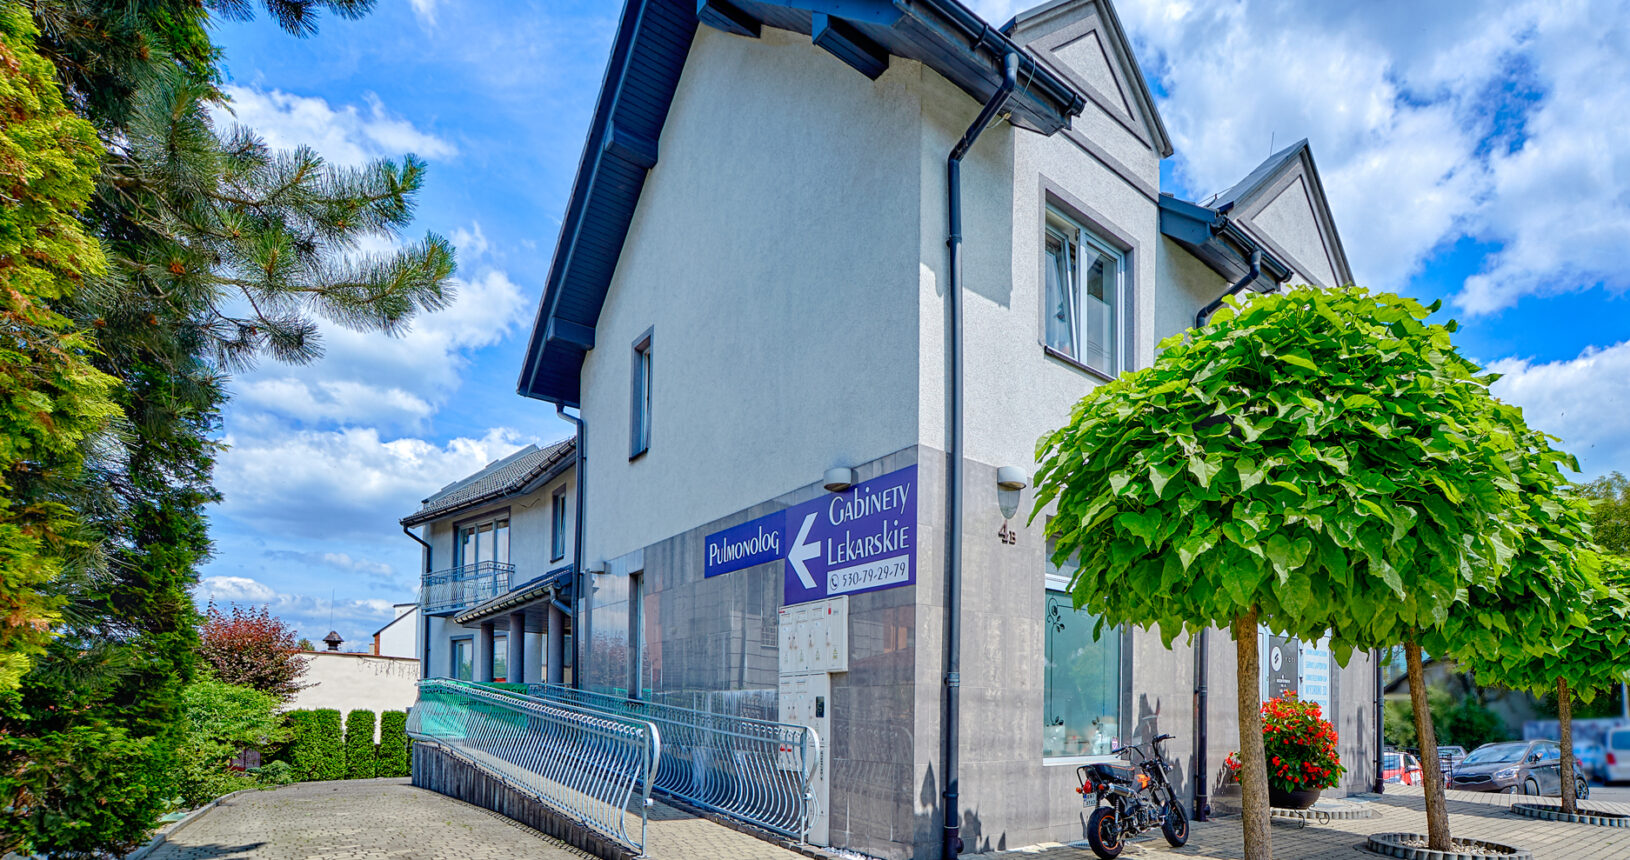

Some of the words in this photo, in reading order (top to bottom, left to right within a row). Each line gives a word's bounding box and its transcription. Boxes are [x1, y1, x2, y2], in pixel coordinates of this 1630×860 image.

[829, 482, 910, 526] Gabinety
[709, 525, 779, 567] Pulmonolog
[827, 519, 910, 566] Lekarskie
[842, 561, 906, 587] 530-79-29-79
